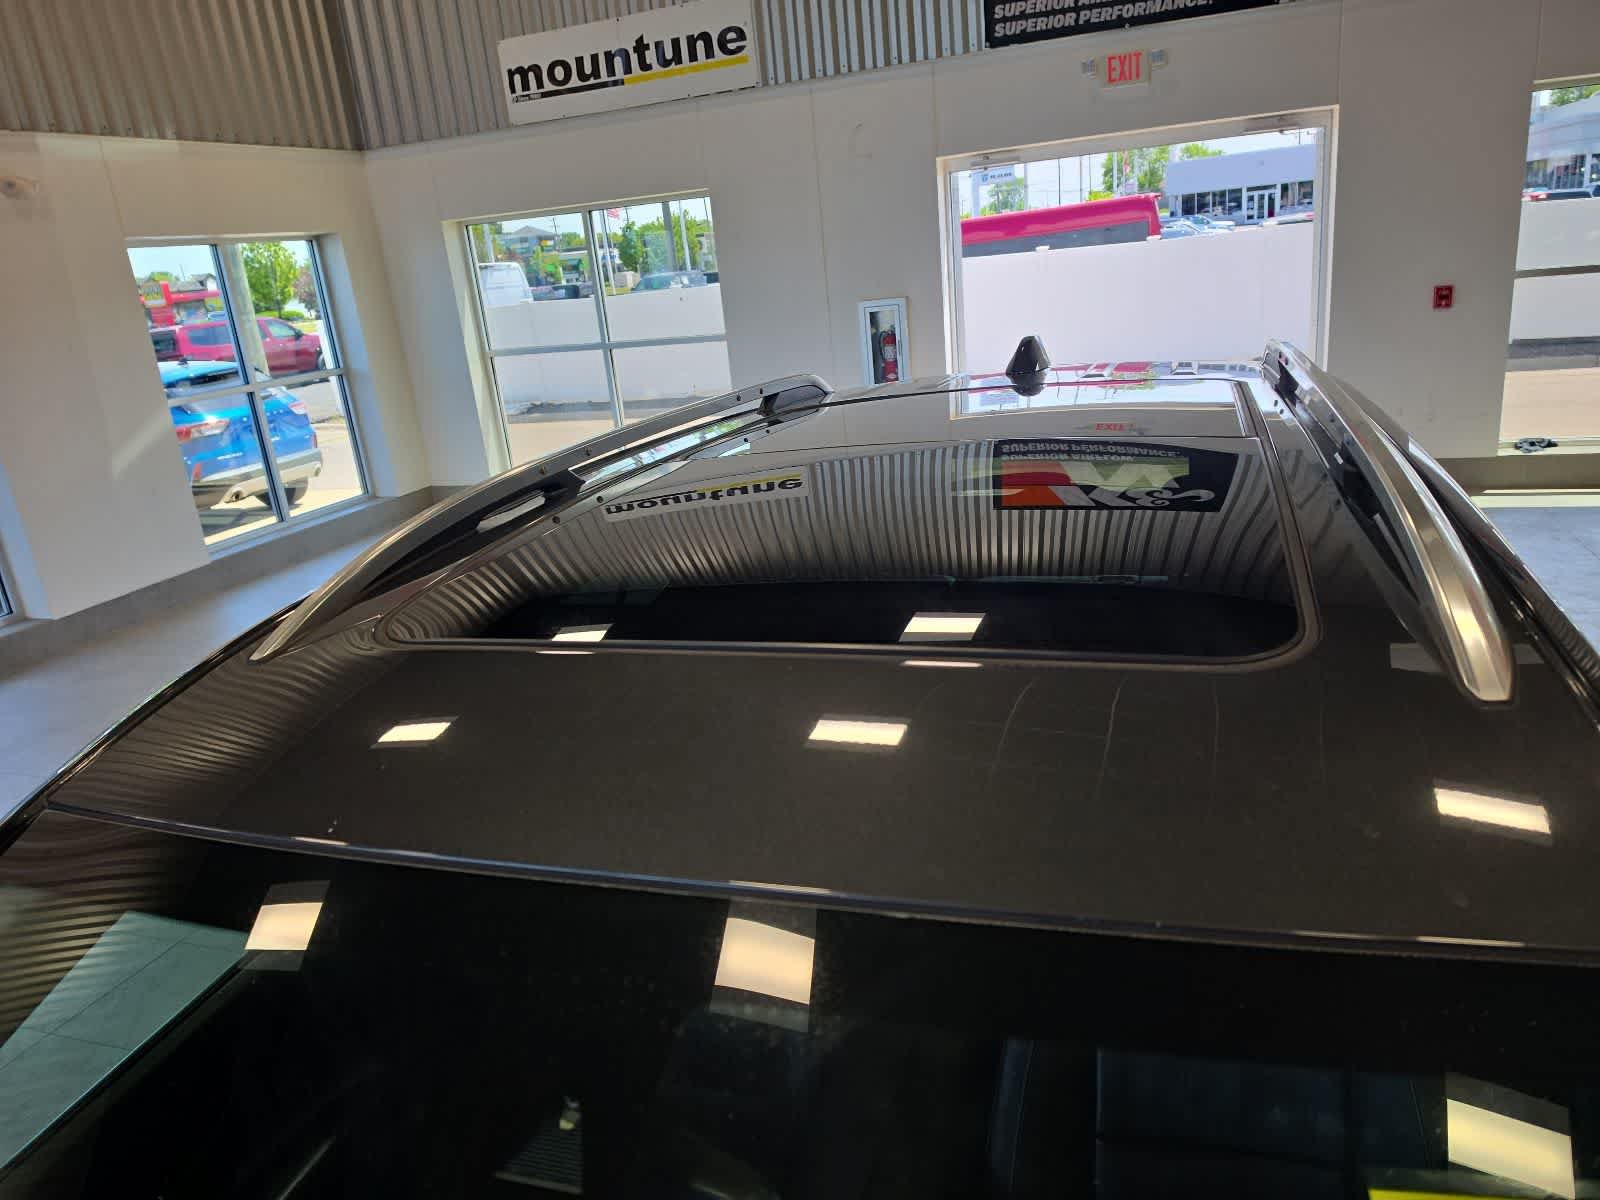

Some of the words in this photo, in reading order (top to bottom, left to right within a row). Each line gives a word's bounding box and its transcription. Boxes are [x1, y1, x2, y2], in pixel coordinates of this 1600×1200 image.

[994, 12, 1077, 37] SUPERIOR
[507, 25, 748, 94] mountune
[1106, 51, 1142, 83] EXIT
